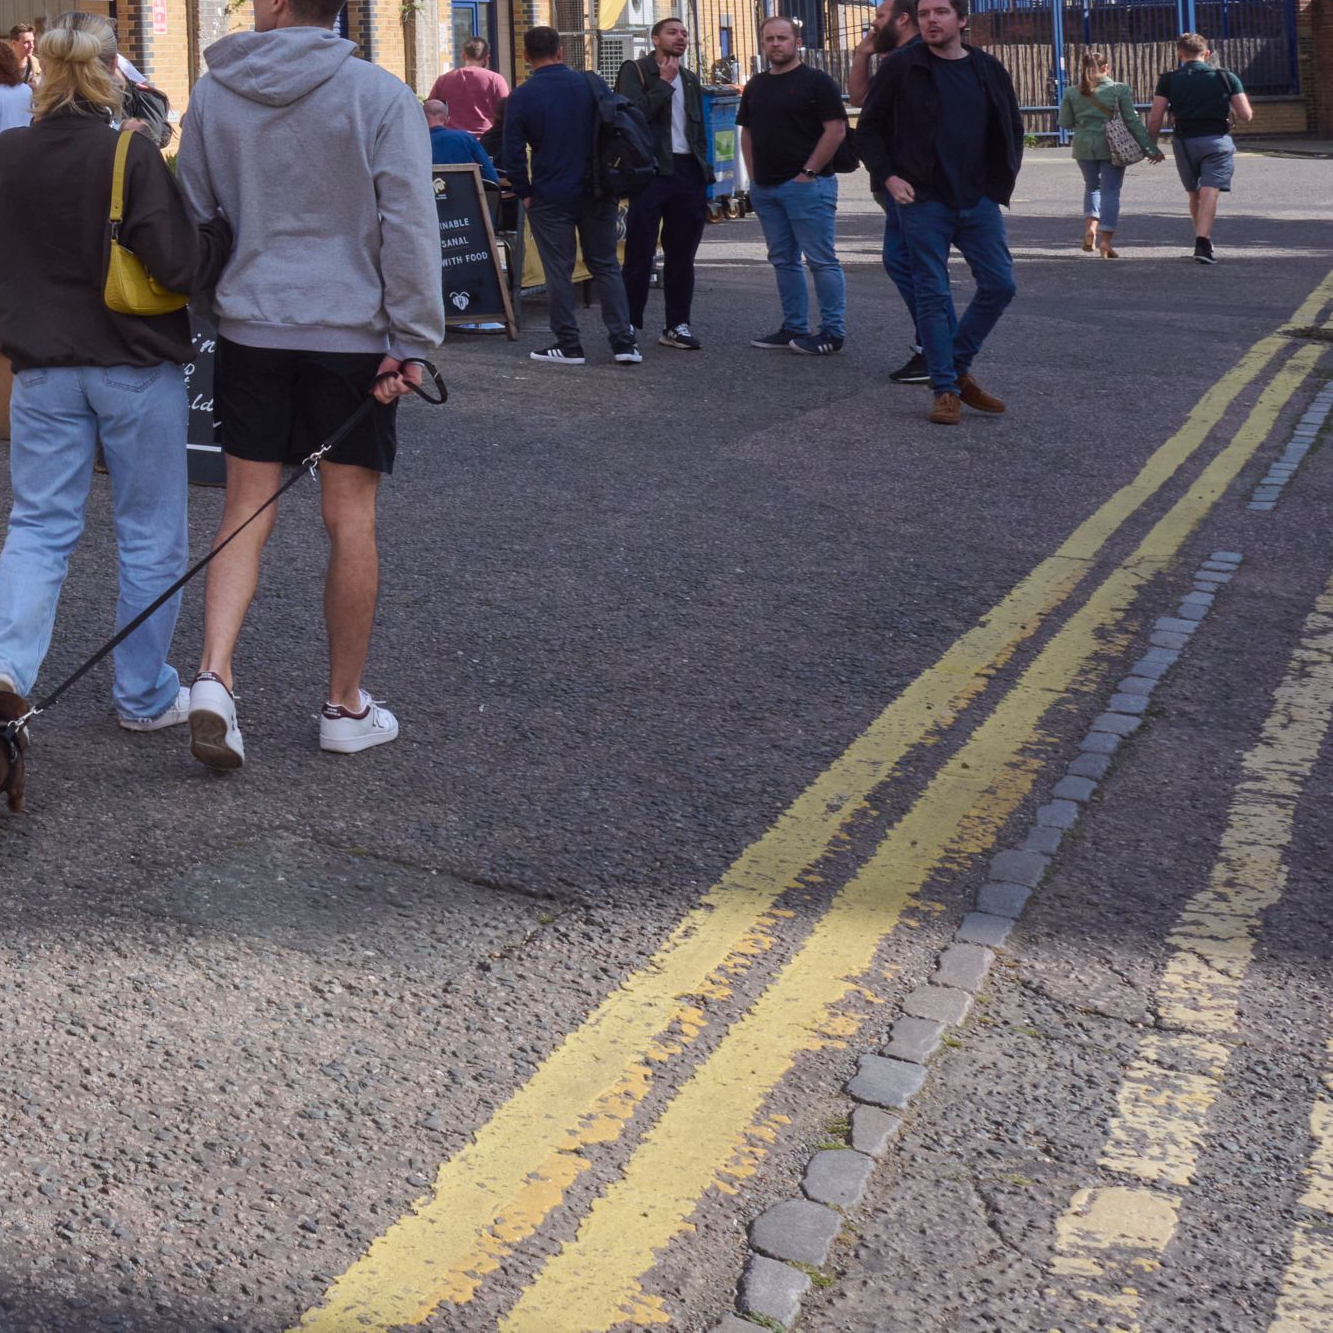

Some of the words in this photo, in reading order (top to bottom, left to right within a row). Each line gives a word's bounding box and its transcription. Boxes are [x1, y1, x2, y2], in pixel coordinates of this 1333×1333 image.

[439, 218, 469, 230] INABLE
[441, 237, 469, 248] SANAL
[465, 252, 488, 263] FOOD
